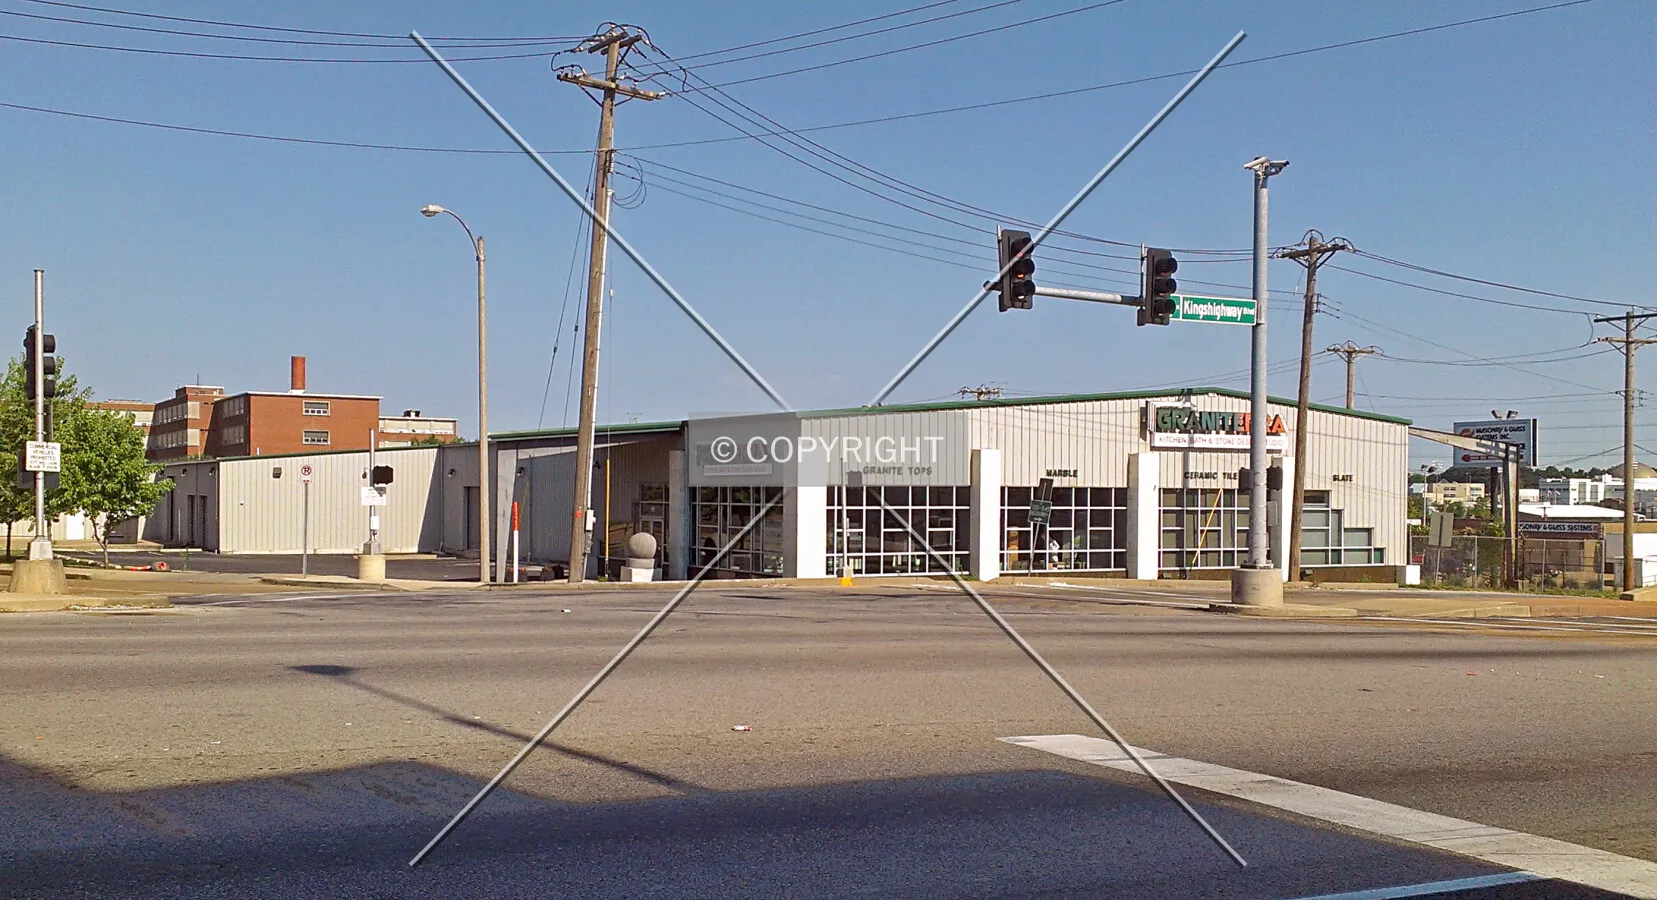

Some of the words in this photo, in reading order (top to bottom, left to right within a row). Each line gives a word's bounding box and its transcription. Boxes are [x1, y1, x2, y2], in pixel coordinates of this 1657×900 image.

[1183, 299, 1243, 321] Kingshighway
[1475, 426, 1503, 434] MASONRY
[1189, 436, 1207, 444] BATH
[1215, 437, 1234, 445] STONE
[862, 466, 903, 475] GRANITE
[908, 466, 933, 475] TOPS
[1046, 469, 1078, 477] MARBLE
[1184, 471, 1218, 480] CERAMIC
[1222, 472, 1239, 480] TILE
[1332, 474, 1353, 482] SLATE
